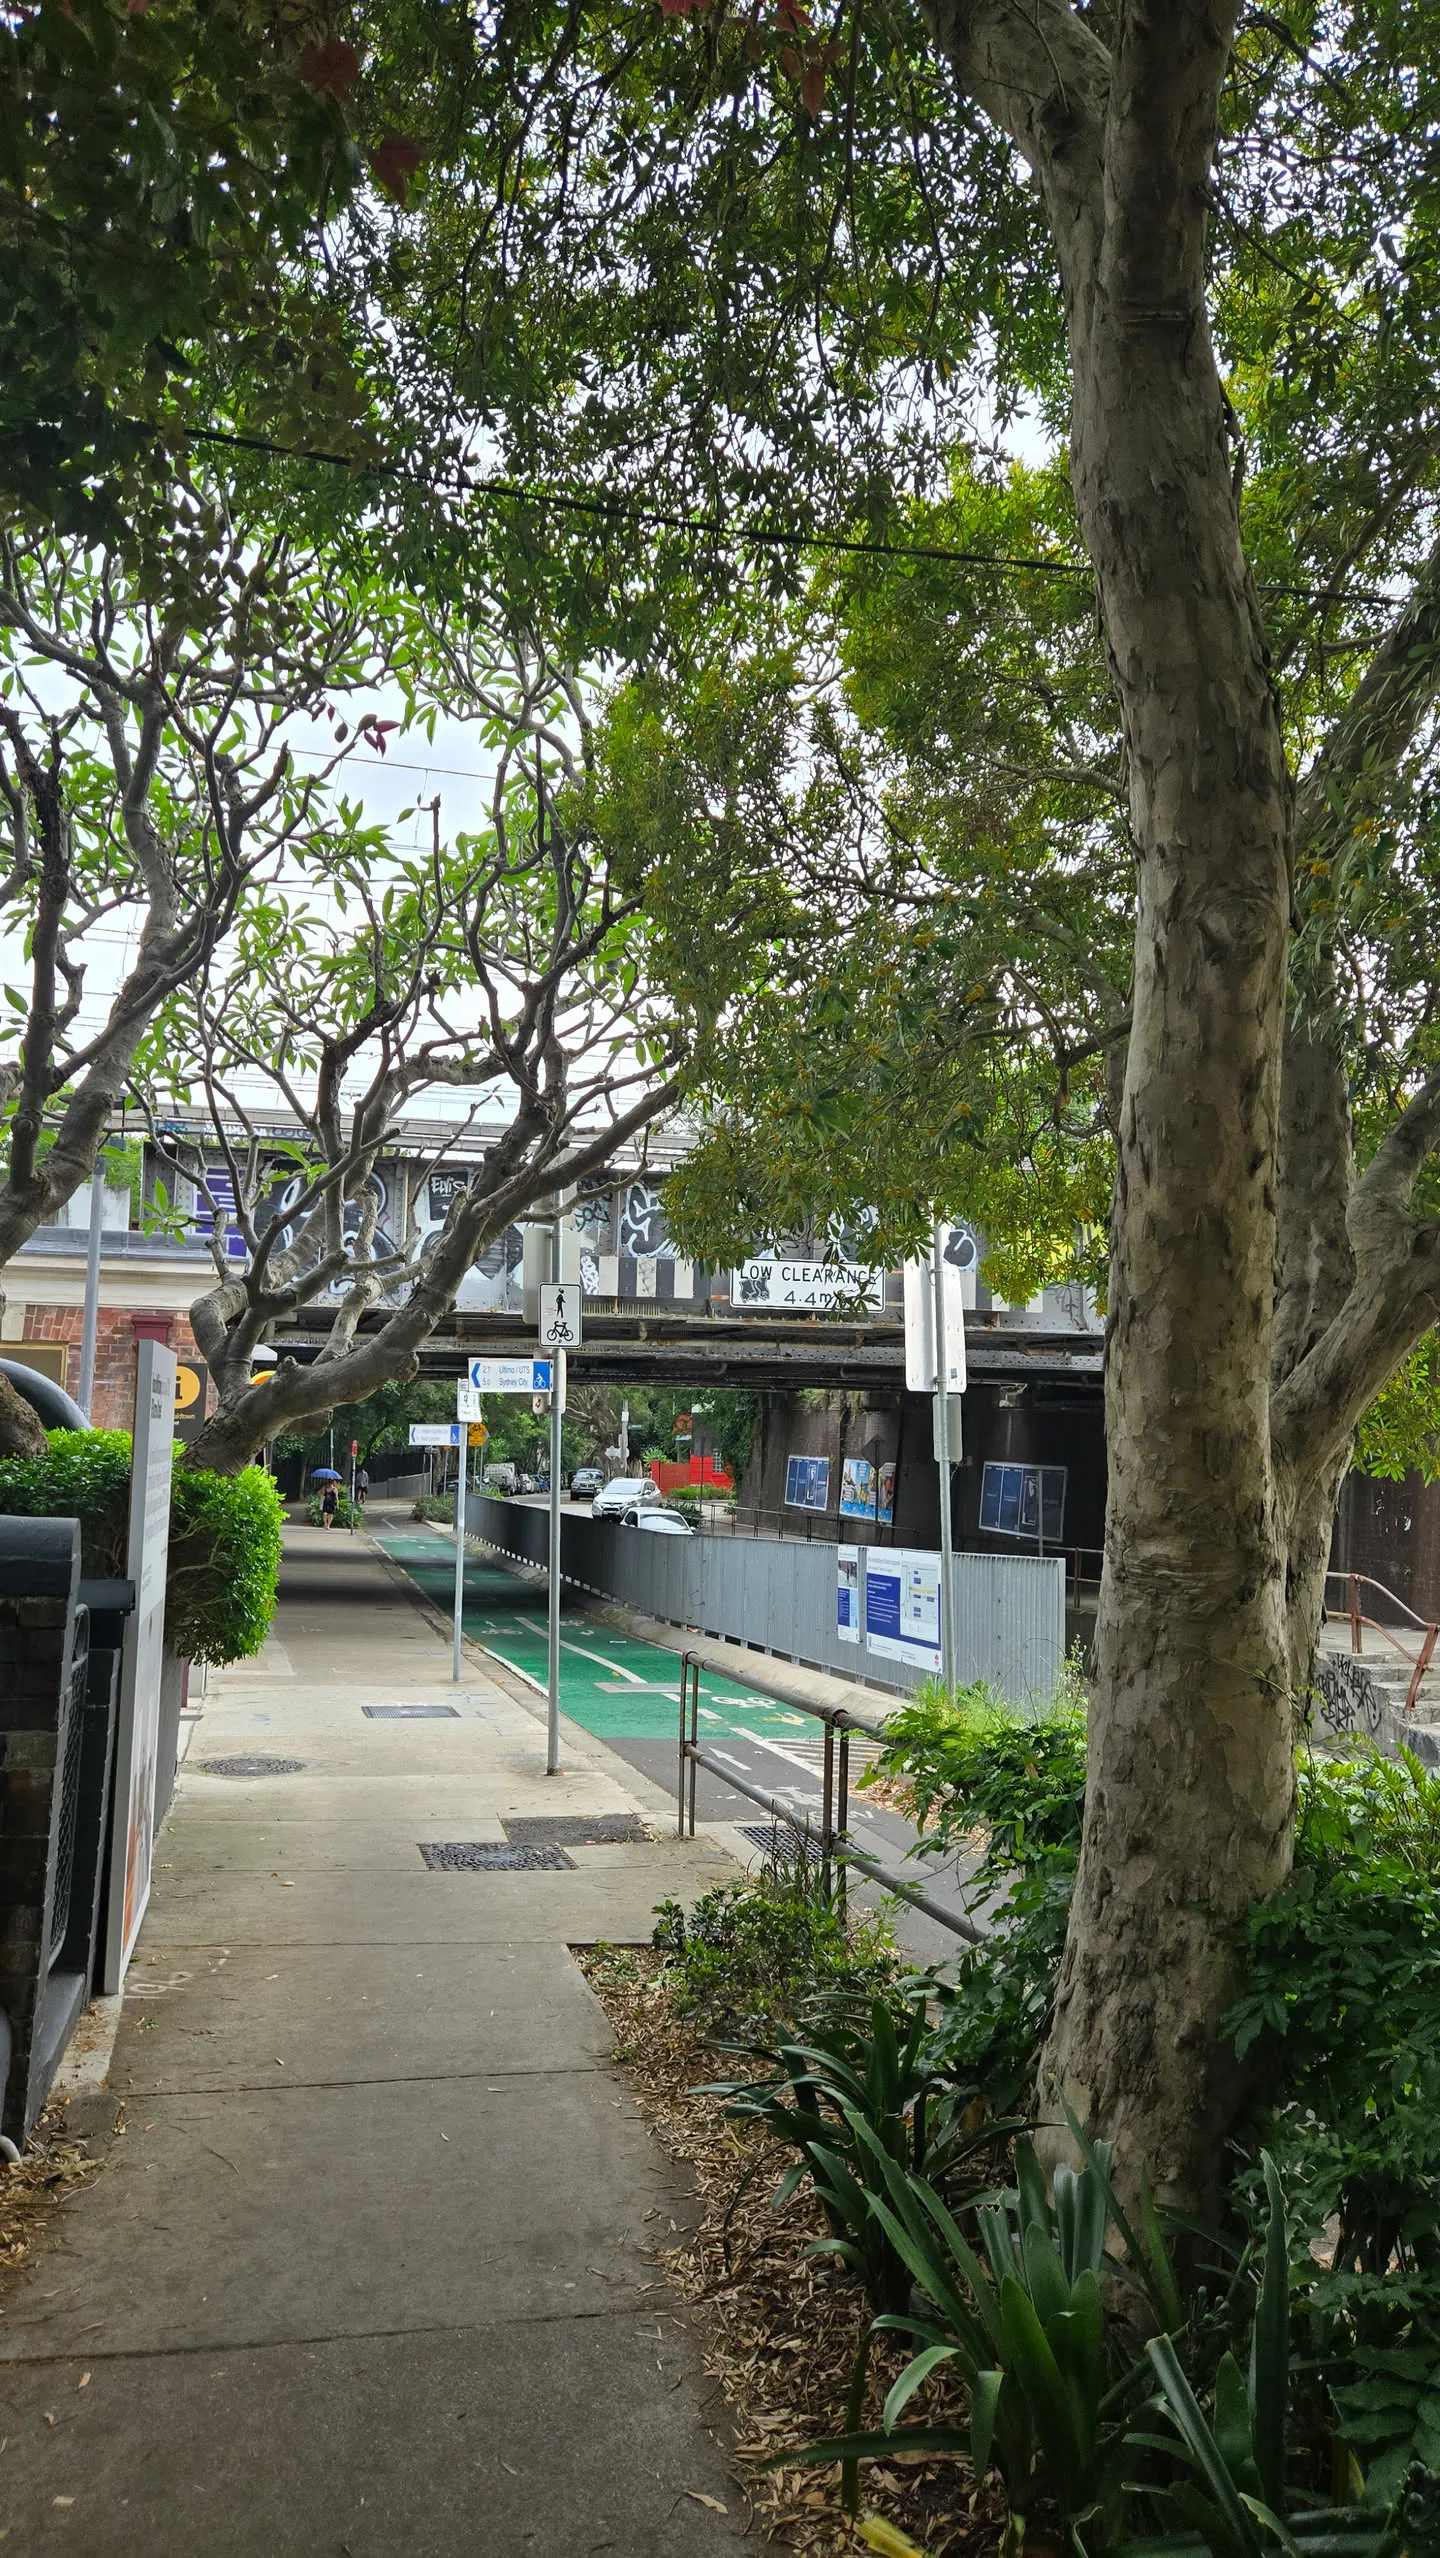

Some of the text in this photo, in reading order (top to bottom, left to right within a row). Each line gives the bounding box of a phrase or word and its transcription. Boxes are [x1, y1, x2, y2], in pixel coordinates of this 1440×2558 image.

[740, 1265, 877, 1285] LOW CLEARANCE
[518, 1366, 530, 1374] UTS
[499, 1377, 517, 1388] Sydney
[518, 1378, 528, 1388] City
